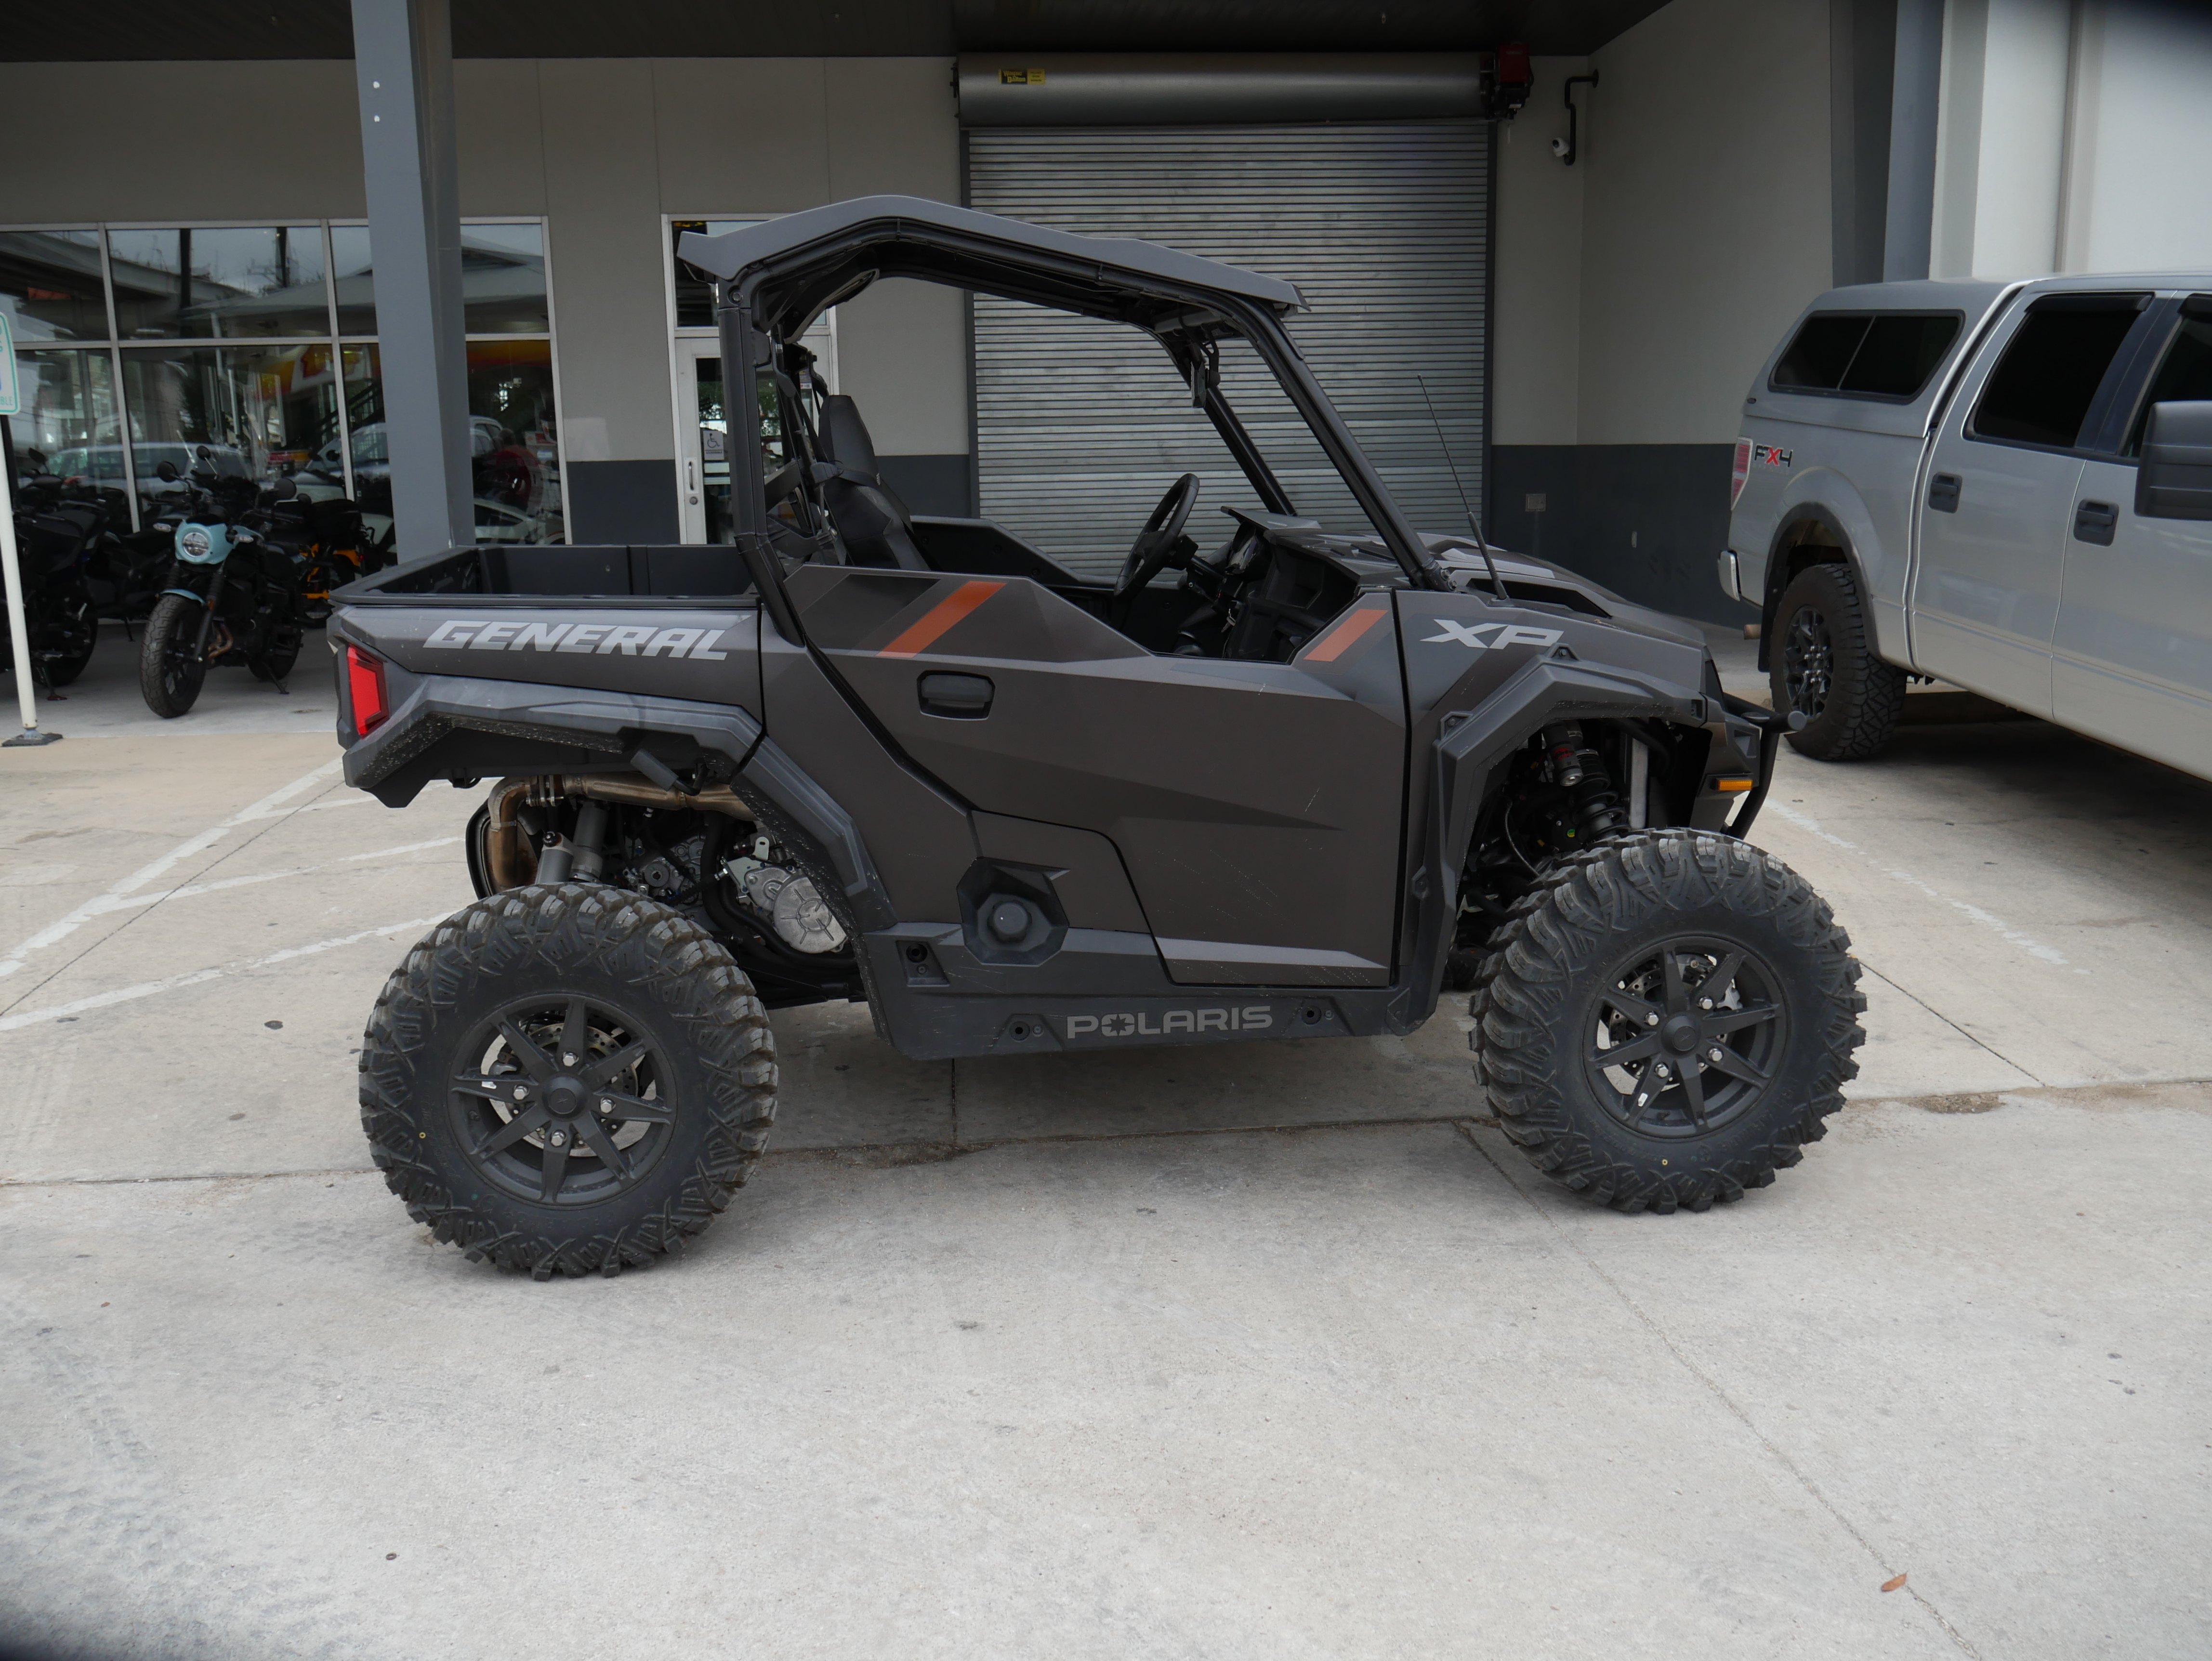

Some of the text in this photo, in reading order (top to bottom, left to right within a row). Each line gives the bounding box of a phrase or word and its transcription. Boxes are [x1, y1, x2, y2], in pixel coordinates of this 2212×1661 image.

[0, 396, 13, 406] BLE
[1754, 444, 1793, 468] FX4
[422, 620, 728, 661] GENERAL
[1420, 619, 1564, 650] XP
[1066, 1005, 1273, 1040] POLARIS
